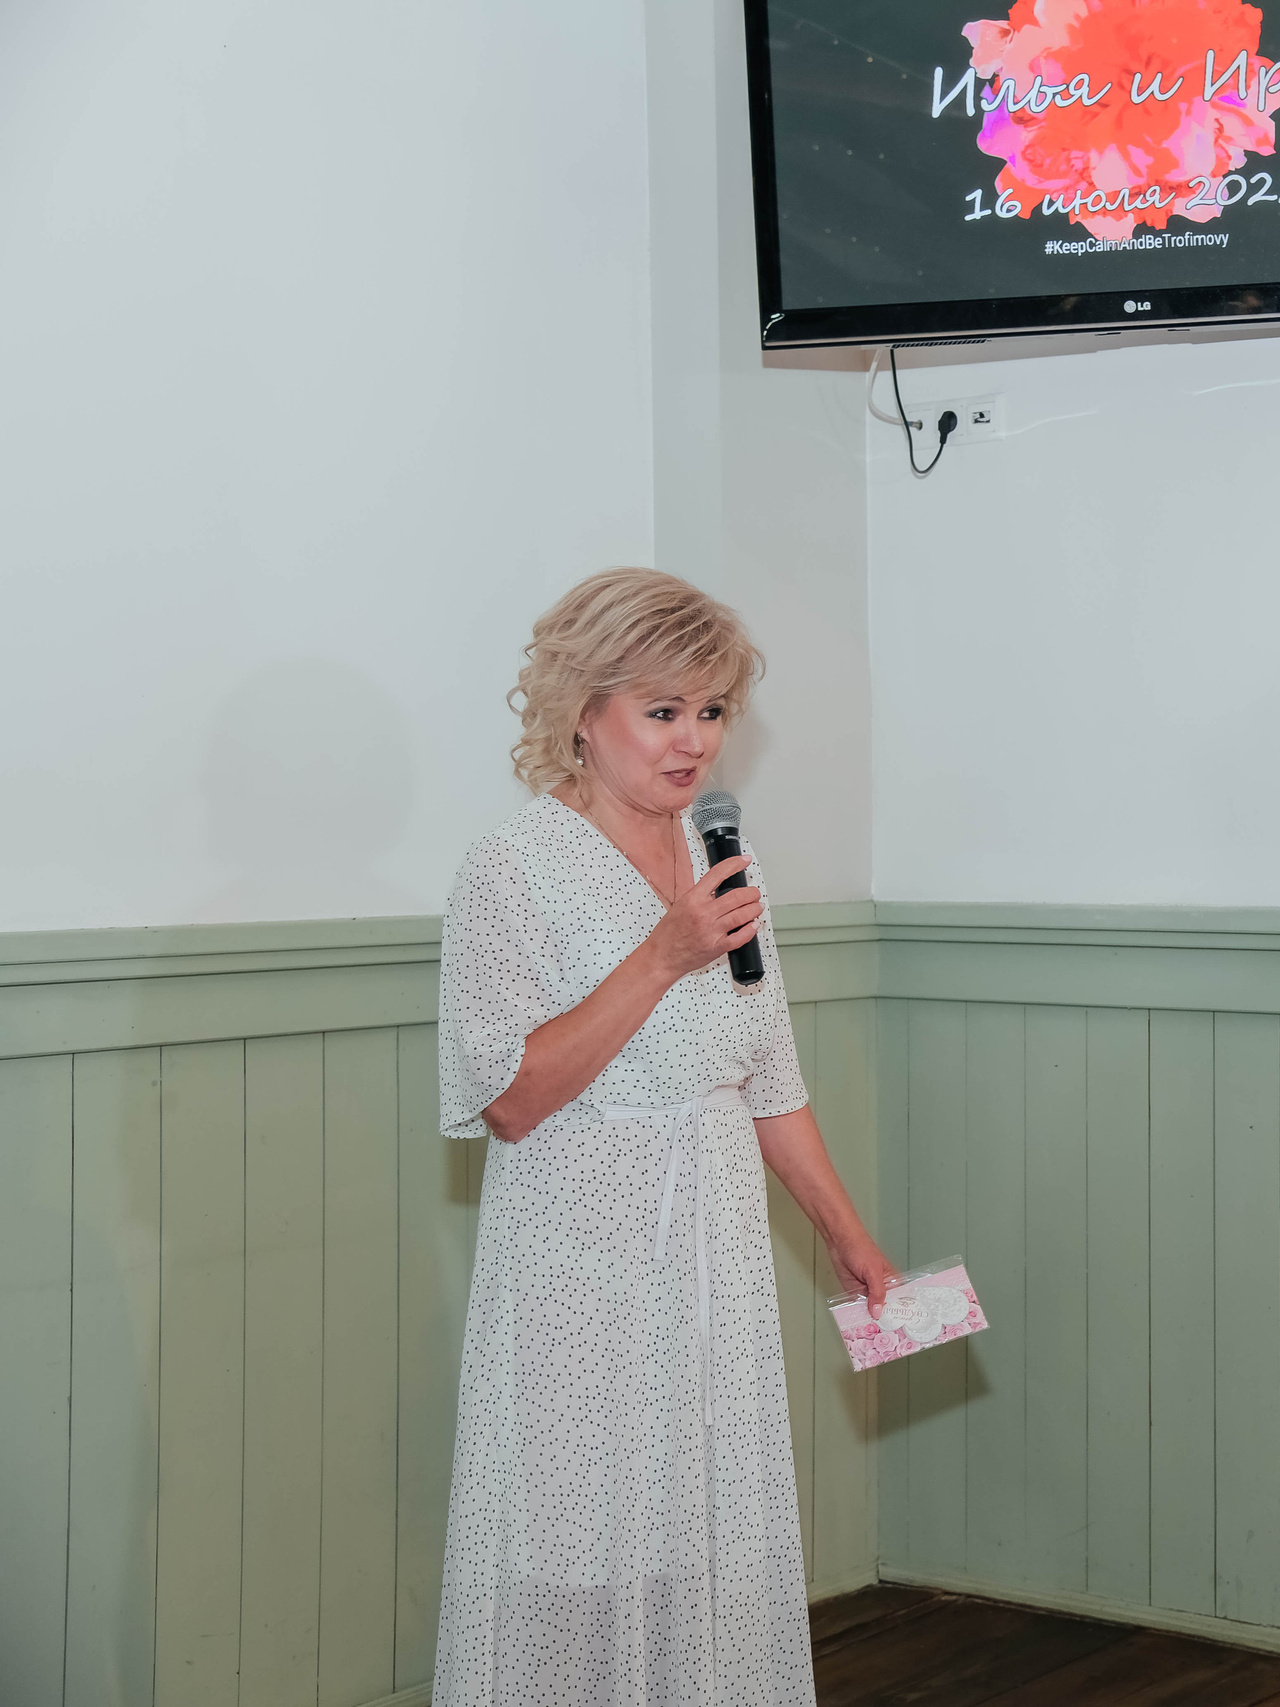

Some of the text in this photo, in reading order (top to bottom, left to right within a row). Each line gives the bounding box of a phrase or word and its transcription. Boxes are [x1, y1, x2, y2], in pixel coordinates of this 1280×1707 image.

[931, 66, 1112, 118] Илья
[1130, 71, 1184, 104] и
[964, 188, 1023, 221] 16
[1041, 184, 1176, 216] июля
[1044, 231, 1230, 257] #KeepCalmAndBeTrofimovy
[1137, 301, 1152, 311] LG
